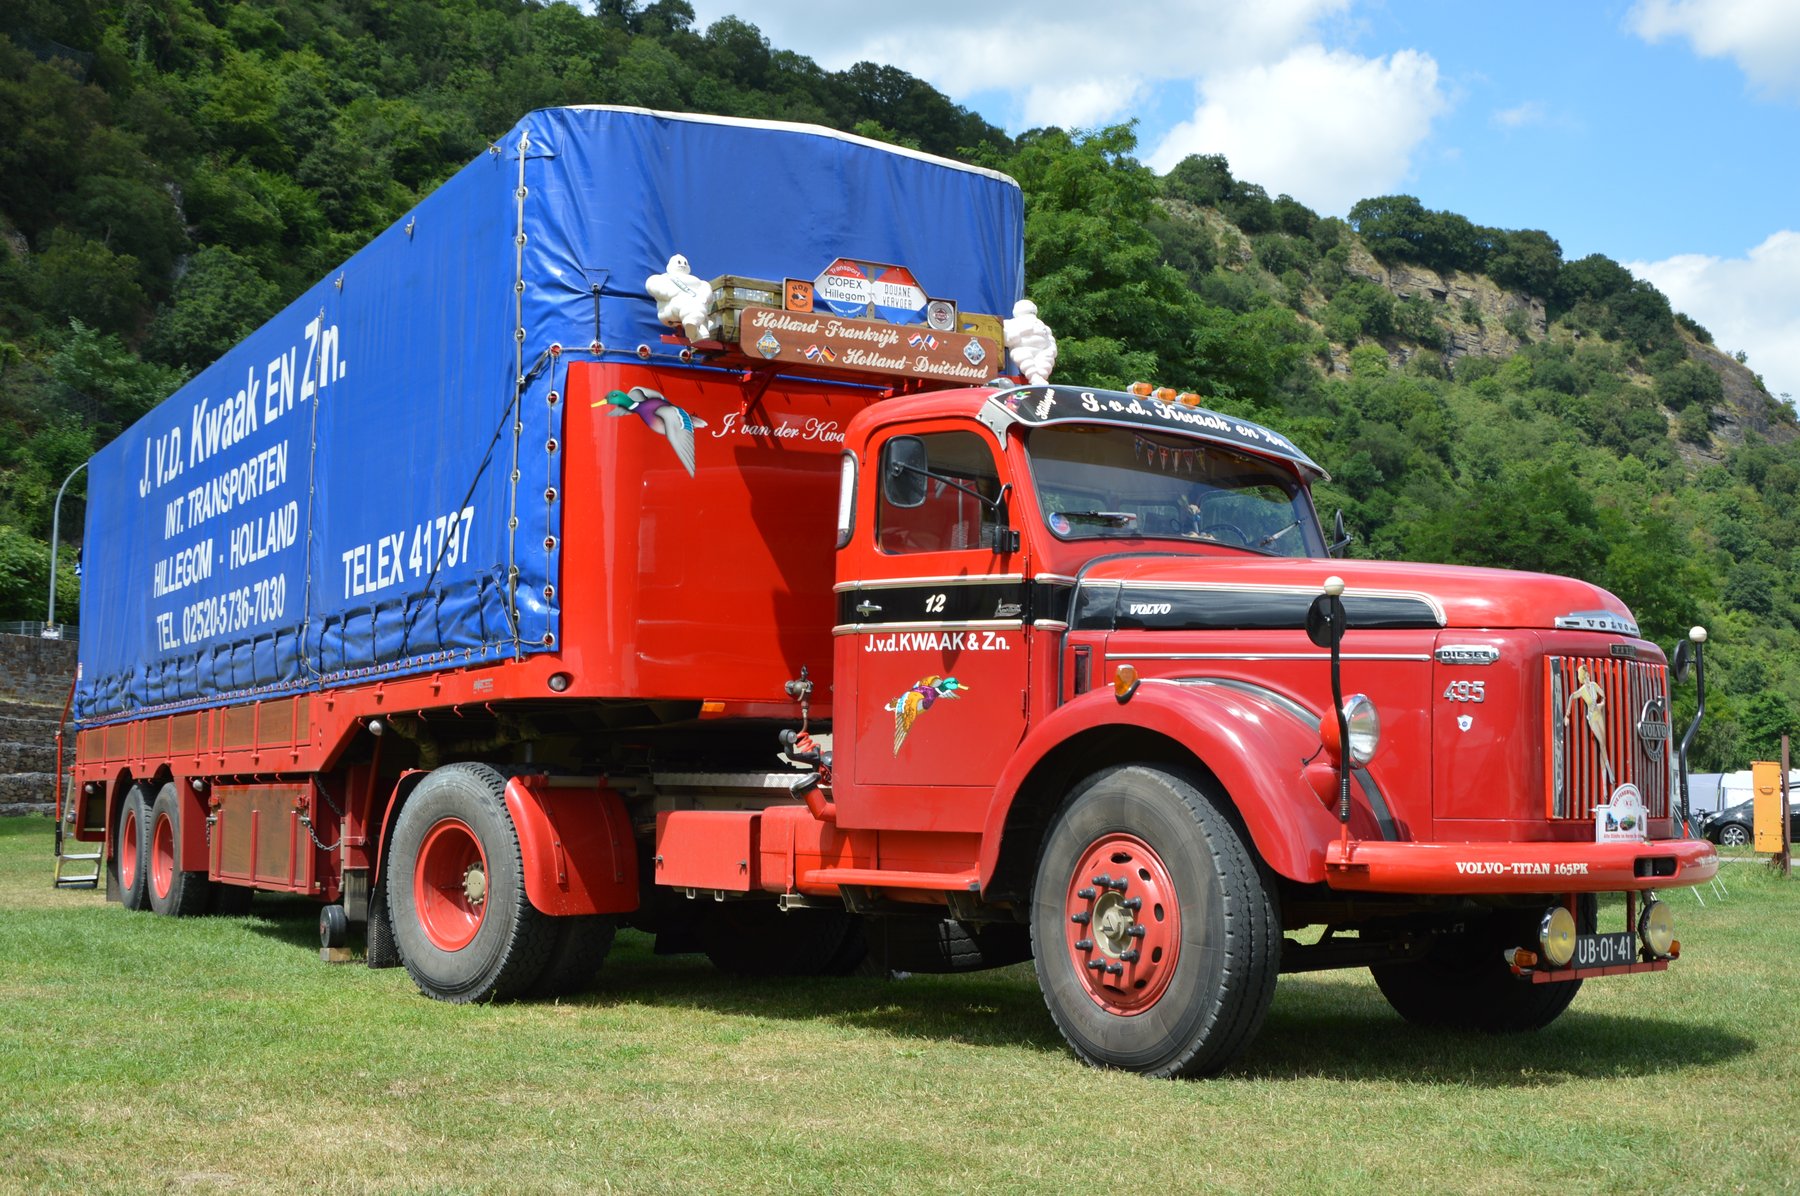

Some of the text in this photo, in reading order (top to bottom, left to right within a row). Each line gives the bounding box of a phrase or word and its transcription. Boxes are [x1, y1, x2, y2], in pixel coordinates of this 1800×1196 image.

[830, 264, 861, 277] Transport
[827, 276, 863, 290] COPEX
[884, 283, 911, 298] DOUANE
[824, 288, 866, 302] Hillegom
[882, 296, 913, 310] VERVOER
[189, 366, 260, 469] Kwaak
[264, 346, 296, 425] EN
[300, 317, 346, 402] Zn.
[711, 411, 740, 438] J.
[741, 423, 770, 436] van
[774, 421, 800, 438] der
[1153, 399, 1232, 433] Kwaak
[1236, 424, 1260, 440] en
[164, 440, 289, 540] INT. TRANSPORTEN
[153, 538, 213, 598] HILLEGOM
[230, 500, 298, 570] HOLLAND
[342, 505, 475, 600] TELEX 41797
[925, 593, 947, 613] 12
[1129, 603, 1172, 615] VOLVO
[156, 611, 181, 651] TEL.
[1586, 619, 1630, 631] VOLVO
[966, 632, 980, 650] &
[982, 631, 1011, 650] Zn.
[1443, 680, 1485, 703] 495
[1642, 724, 1667, 738] VOLVO
[1455, 862, 1589, 875] VOLVO-TITAN 165PK
[1578, 935, 1632, 964] UB-01-41
